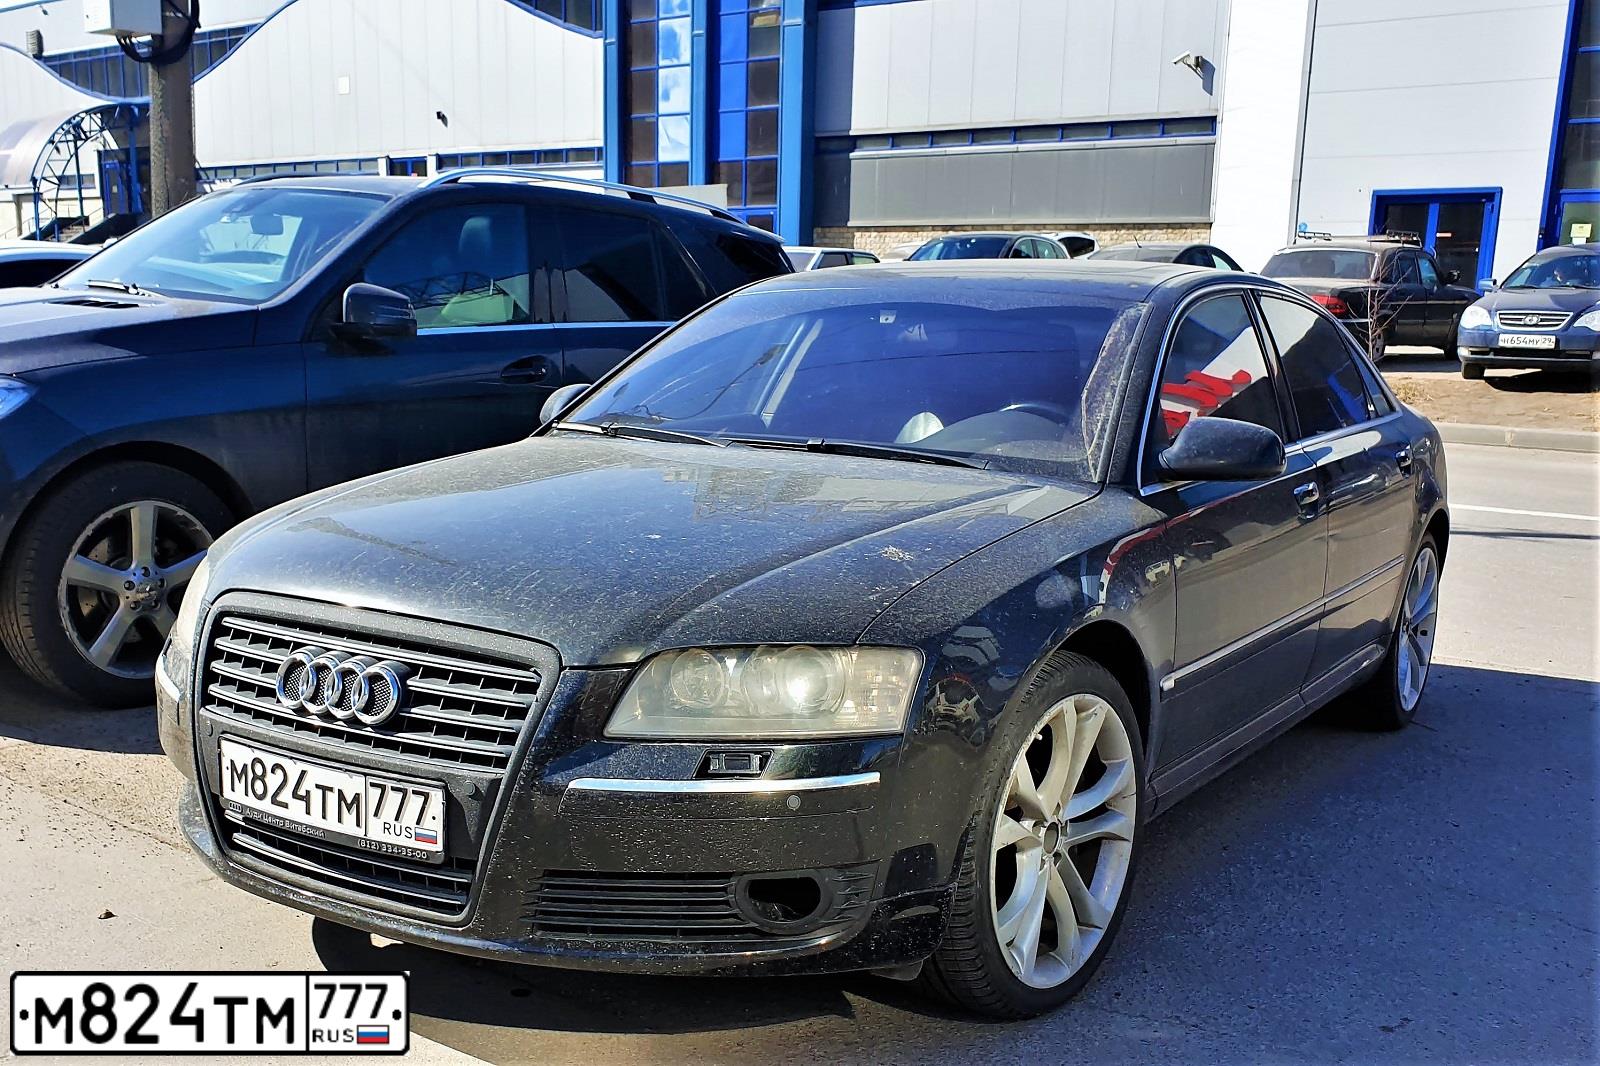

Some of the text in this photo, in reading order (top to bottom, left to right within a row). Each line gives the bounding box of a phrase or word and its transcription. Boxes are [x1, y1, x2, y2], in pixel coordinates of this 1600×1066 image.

[230, 757, 430, 828] М824ТМ 777
[263, 812, 285, 828] Центр
[383, 822, 413, 839] RUS
[357, 839, 428, 860] (812) 334-35-00
